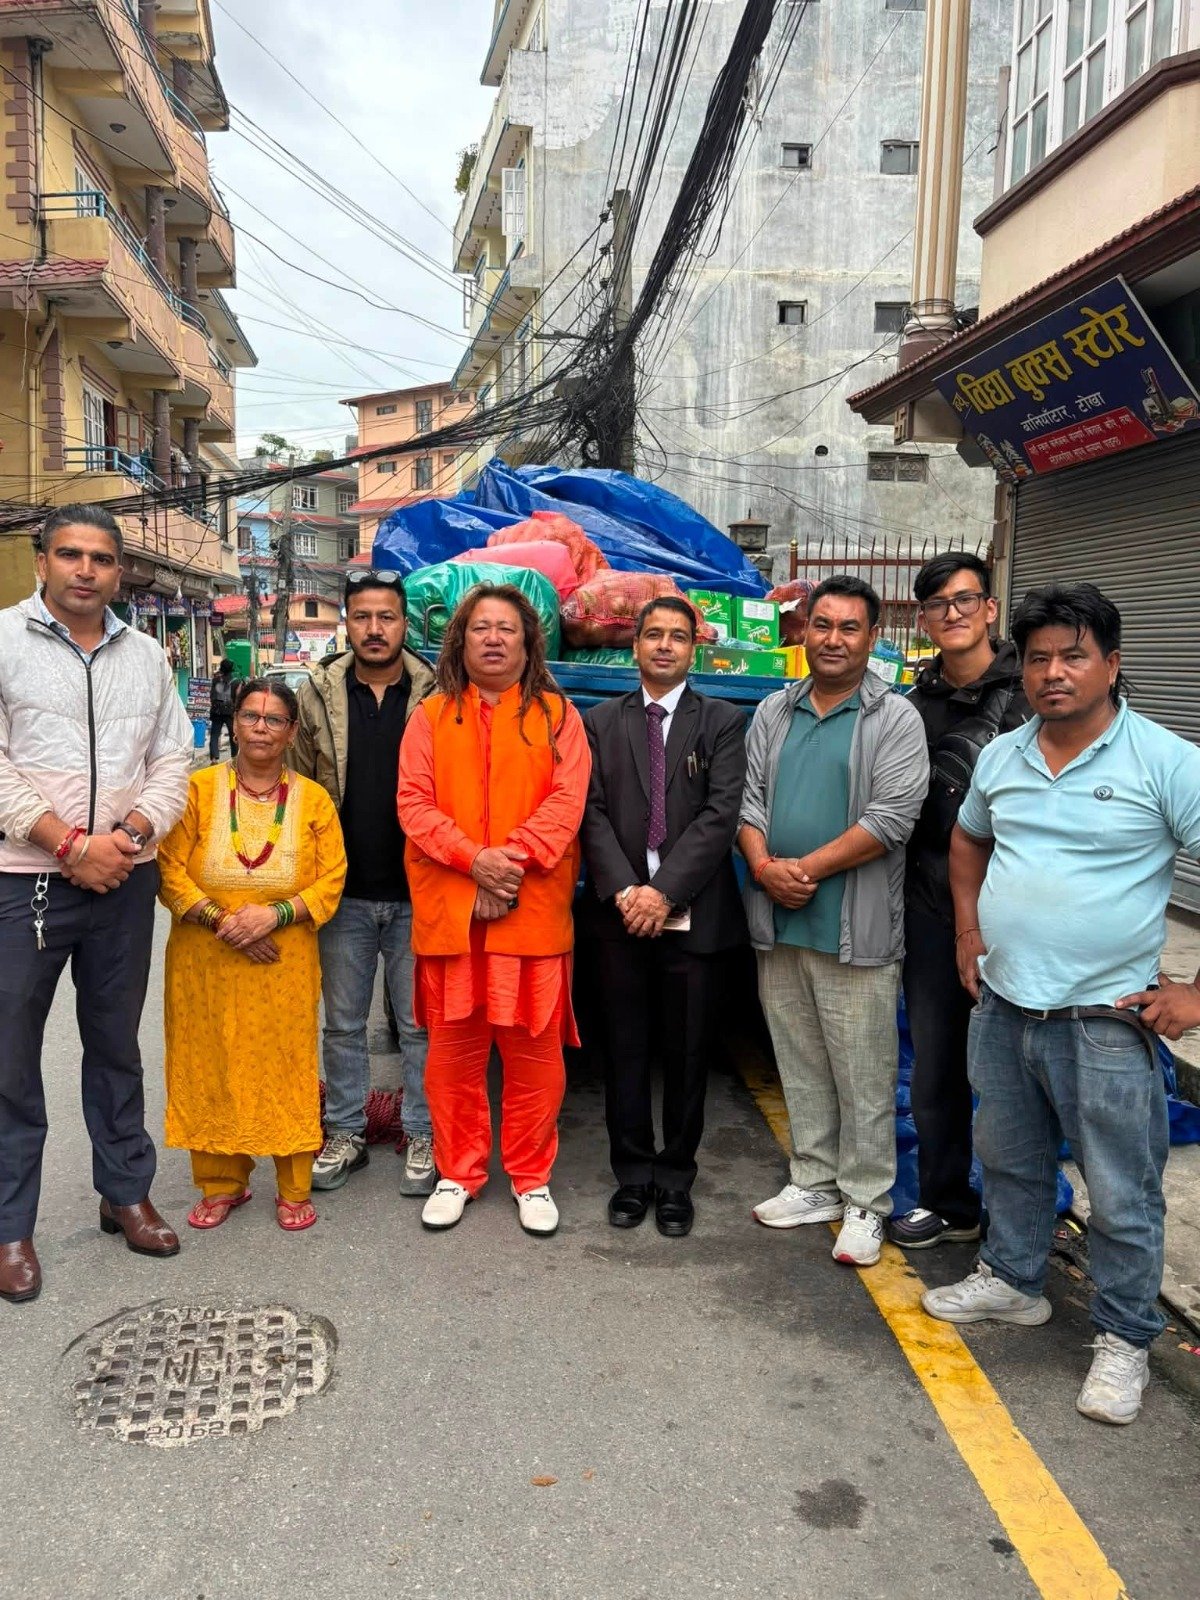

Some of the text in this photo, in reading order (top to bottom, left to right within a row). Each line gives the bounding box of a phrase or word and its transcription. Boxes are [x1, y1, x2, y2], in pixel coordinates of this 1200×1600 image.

[956, 368, 1017, 416] विद्या
[1005, 339, 1074, 402] बुक्स
[1062, 303, 1146, 368] स्टोर
[1076, 391, 1107, 413] टोखा
[803, 1193, 826, 1206] N
[146, 1421, 225, 1439] 2062
